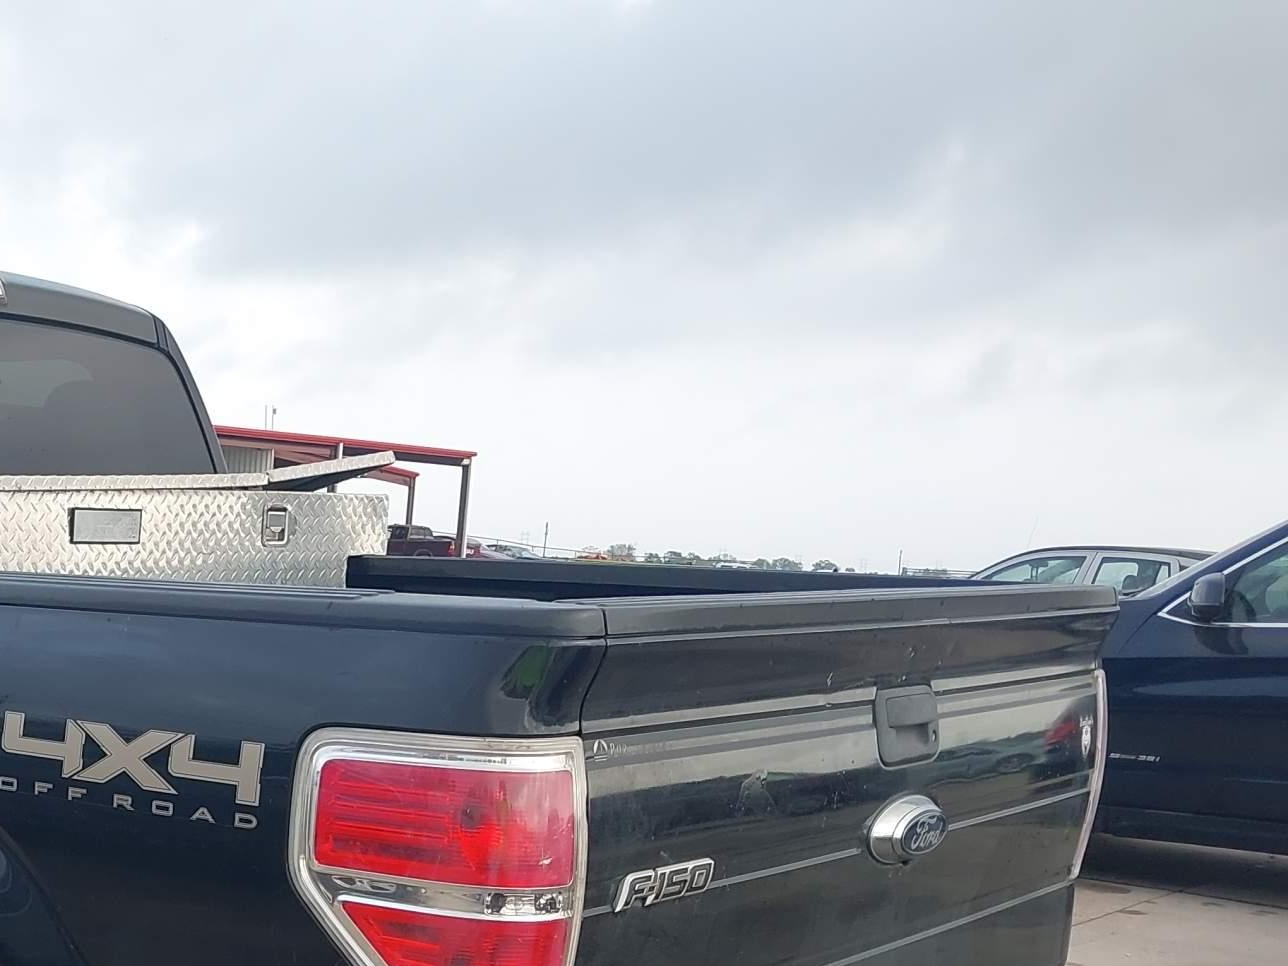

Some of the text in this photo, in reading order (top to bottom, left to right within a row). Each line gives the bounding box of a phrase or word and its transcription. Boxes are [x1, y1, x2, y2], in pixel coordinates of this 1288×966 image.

[1, 711, 265, 806] 4X4
[113, 794, 258, 829] ROAD
[911, 813, 943, 850] Ford
